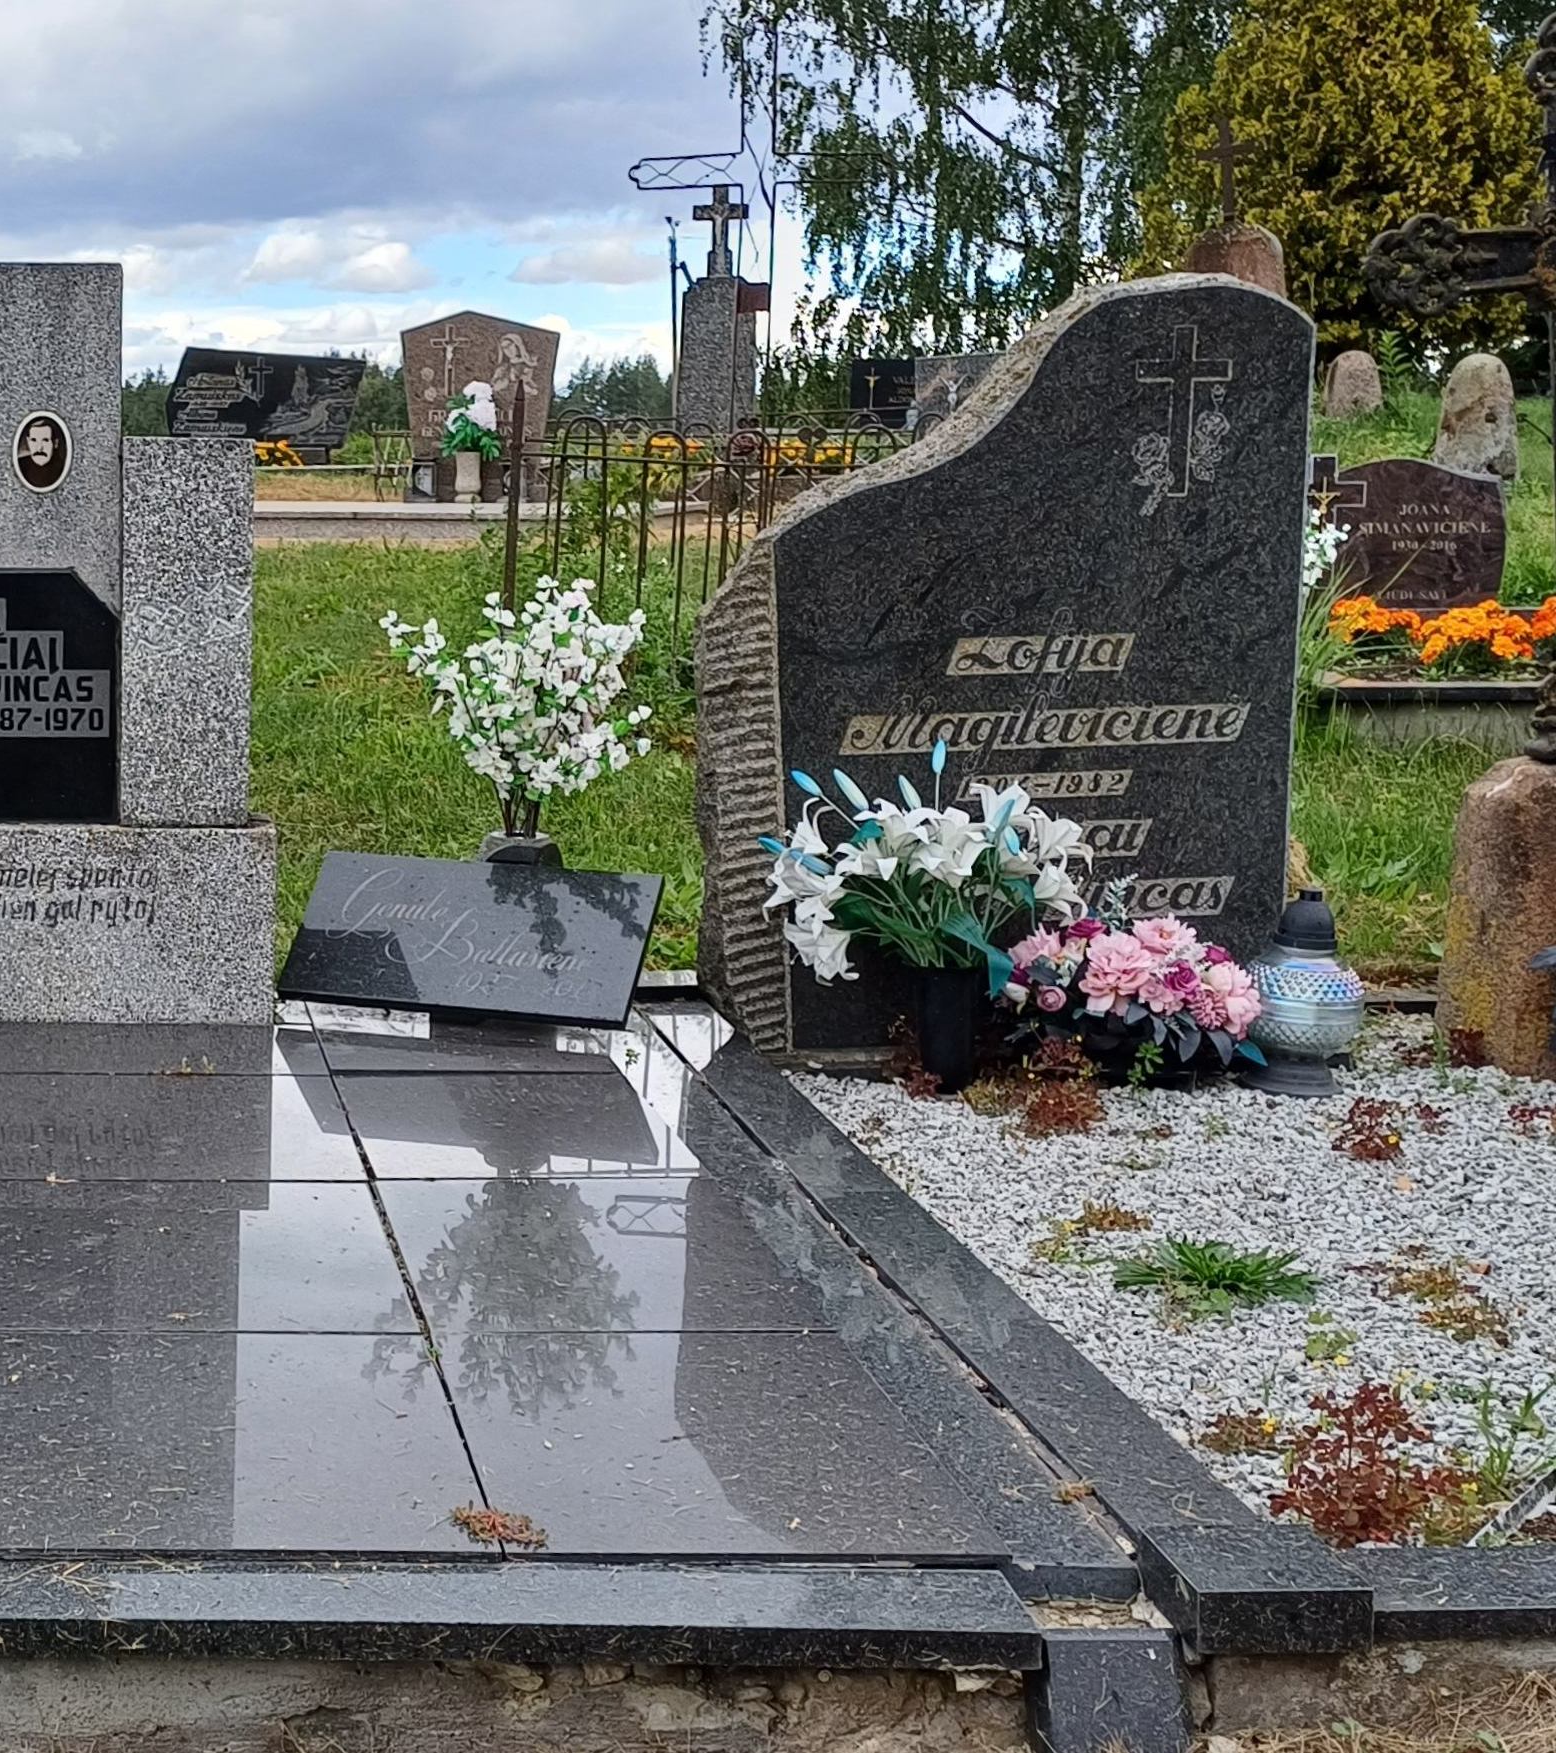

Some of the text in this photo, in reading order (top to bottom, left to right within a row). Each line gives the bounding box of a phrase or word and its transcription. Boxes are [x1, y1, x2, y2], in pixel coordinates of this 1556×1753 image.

[1399, 503, 1450, 516] JOANA
[955, 606, 1127, 698] Zofija
[1082, 862, 1223, 912] incas
[44, 894, 83, 929] gal
